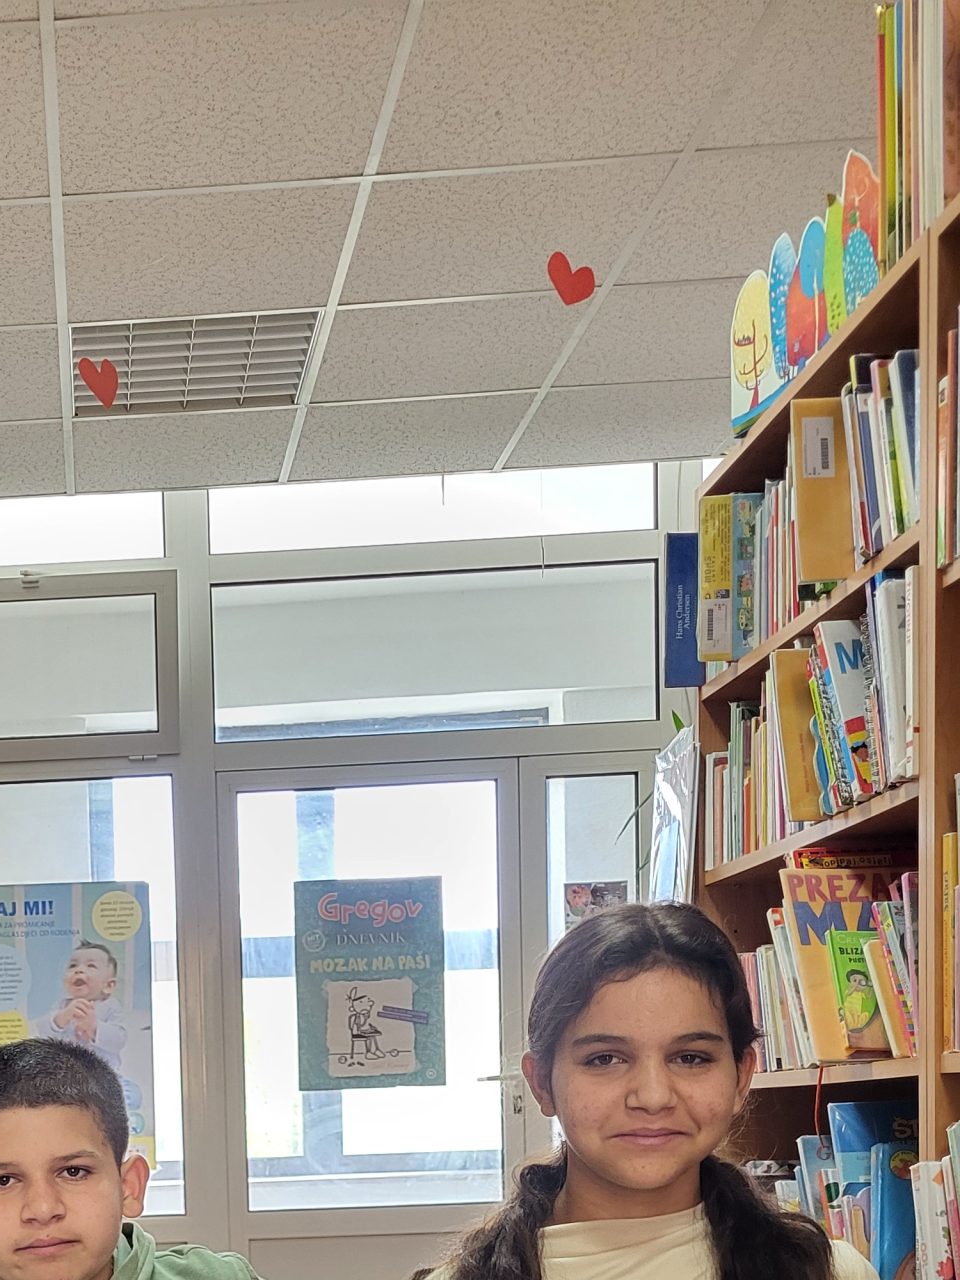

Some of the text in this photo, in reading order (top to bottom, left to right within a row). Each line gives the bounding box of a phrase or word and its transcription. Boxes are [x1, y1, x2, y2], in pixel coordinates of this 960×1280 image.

[675, 584, 683, 639] Hans Christian
[683, 594, 691, 630] Andersen
[788, 873, 892, 902] PREZA
[24, 900, 54, 916] MI!
[318, 893, 423, 927] Gregov
[309, 951, 431, 974] MOZAK NA PAŠI
